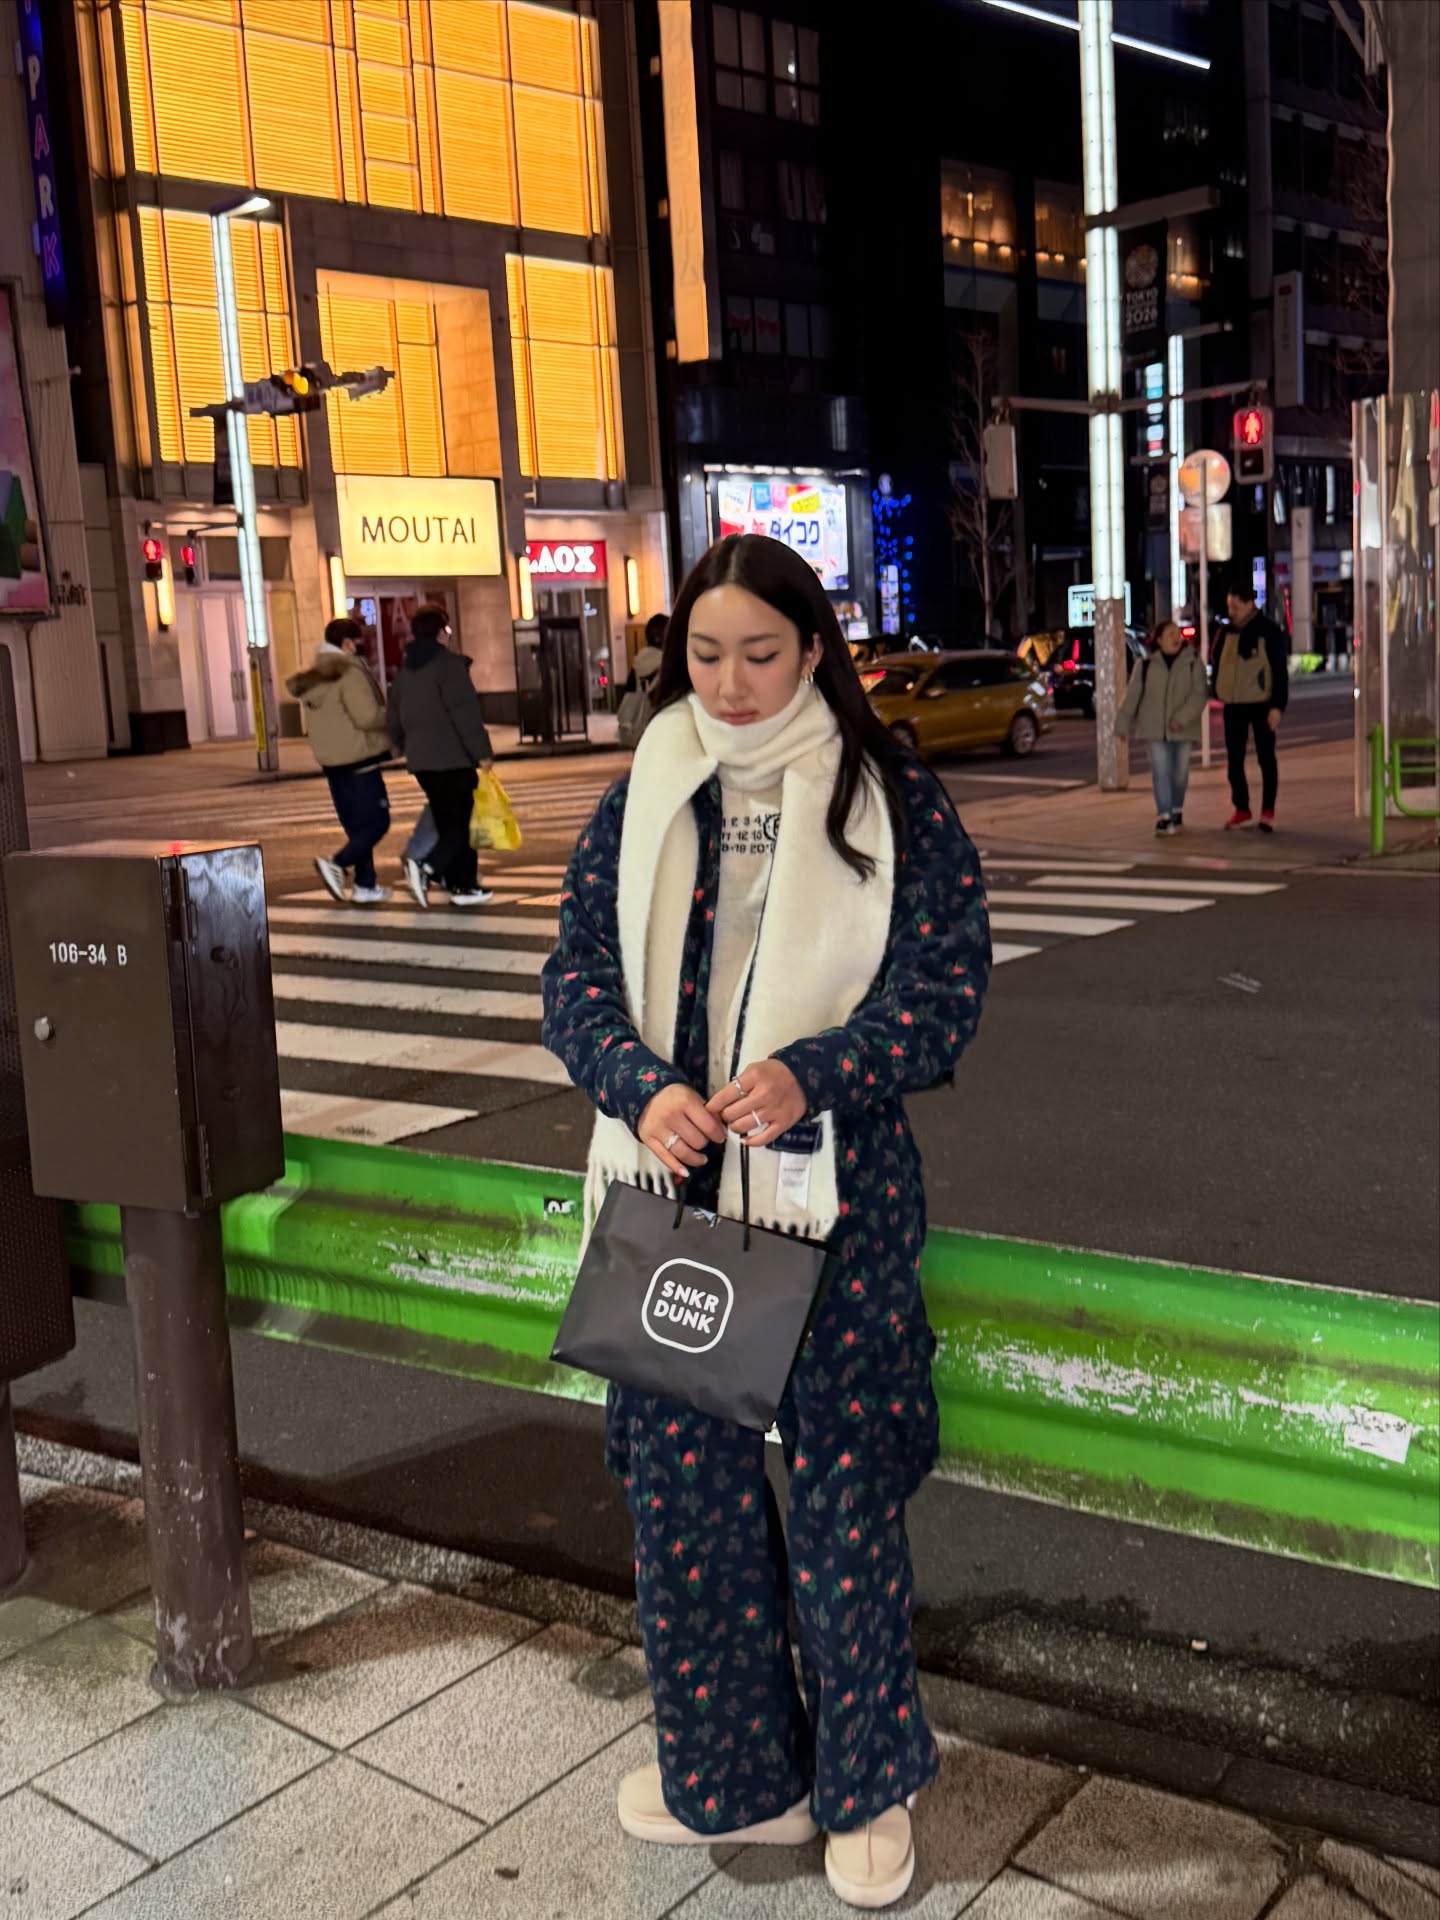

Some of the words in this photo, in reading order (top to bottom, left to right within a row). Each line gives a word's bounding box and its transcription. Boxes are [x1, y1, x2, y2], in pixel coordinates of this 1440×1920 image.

[28, 54, 60, 278] PARK
[361, 516, 476, 544] MOUTAI
[770, 518, 820, 545] ダイコク
[49, 942, 107, 966] 106-34
[117, 944, 128, 966] B
[661, 1280, 719, 1313] SNKR
[653, 1299, 715, 1334] DUNK
